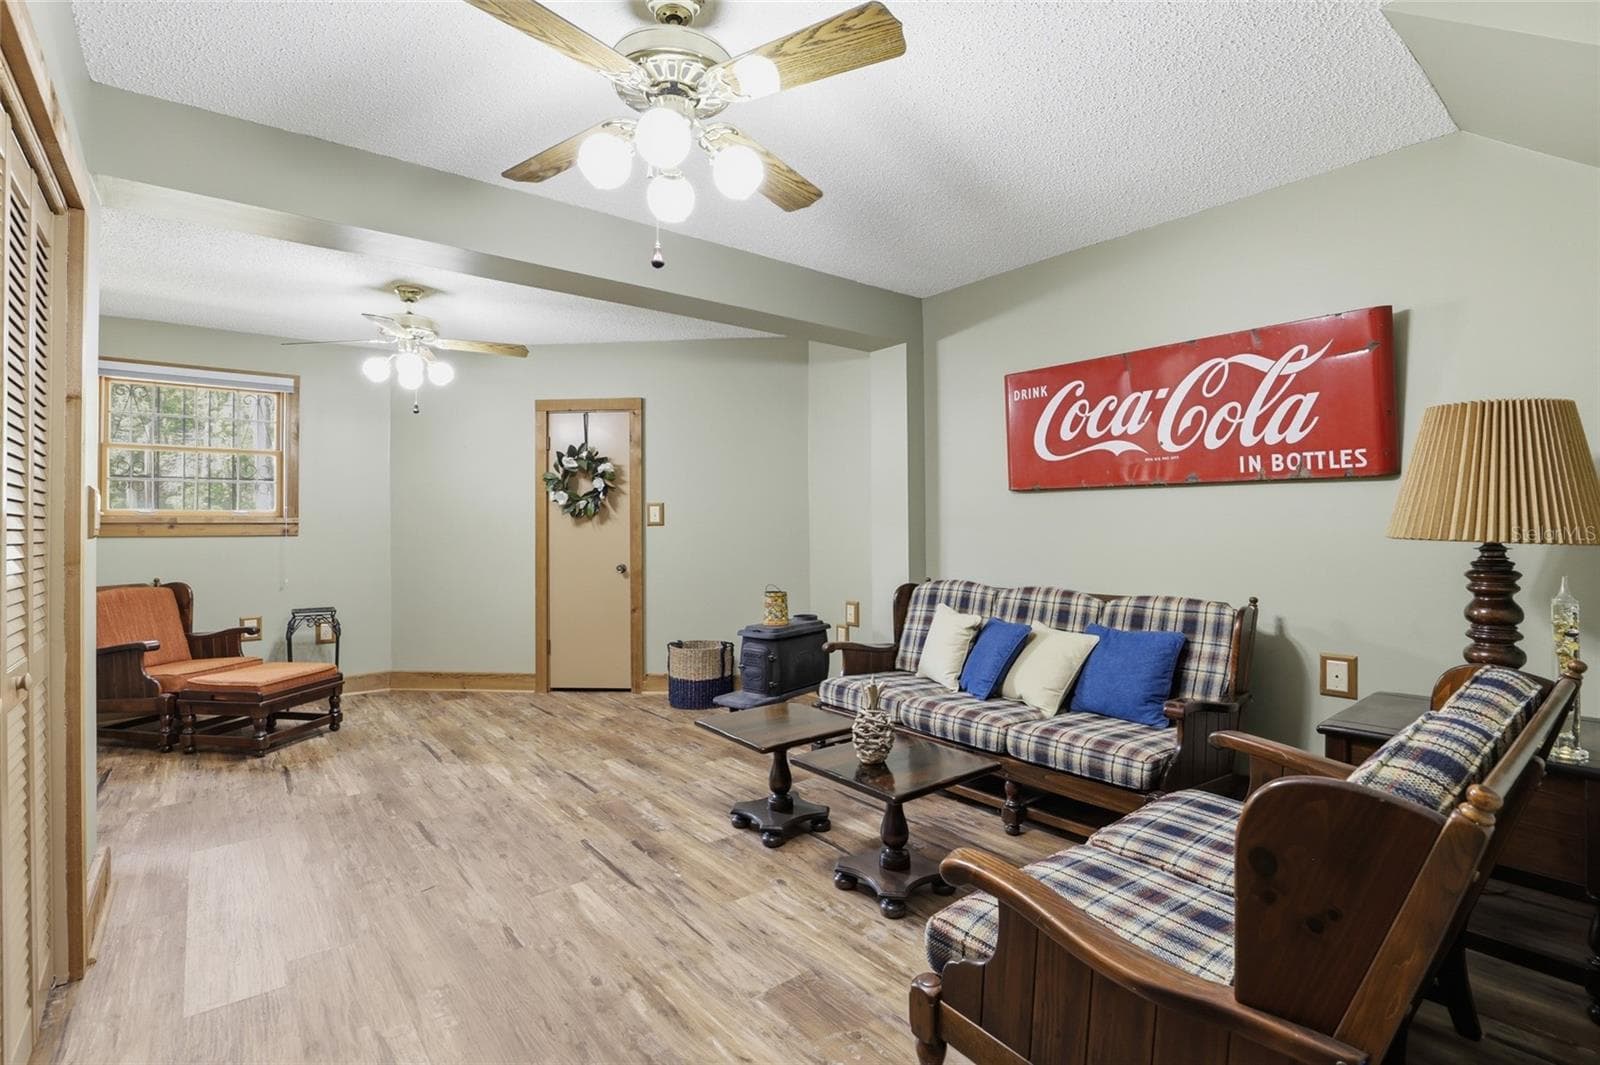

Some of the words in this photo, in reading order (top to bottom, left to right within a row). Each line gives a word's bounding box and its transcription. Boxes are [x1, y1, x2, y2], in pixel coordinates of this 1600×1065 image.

[1013, 385, 1048, 401] DRINK
[1033, 338, 1334, 462] Coca-Cola
[1239, 455, 1261, 473] IN
[1271, 448, 1368, 472] BOTTLES
